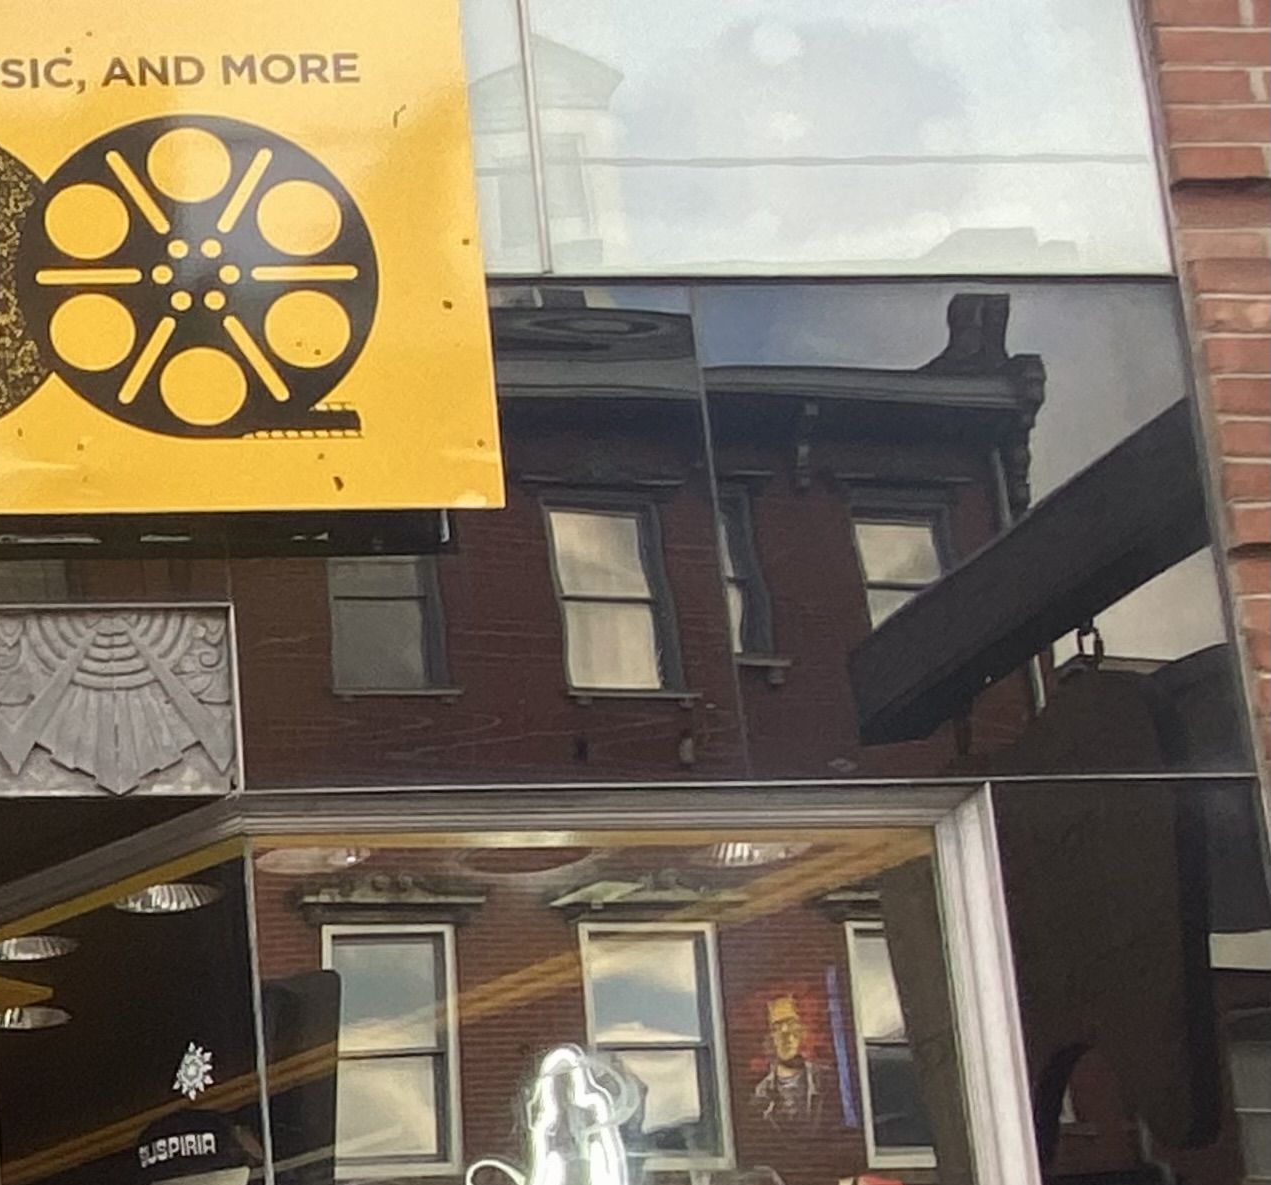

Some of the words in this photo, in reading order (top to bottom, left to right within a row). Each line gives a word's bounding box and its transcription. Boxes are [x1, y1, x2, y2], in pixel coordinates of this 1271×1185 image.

[102, 54, 207, 88] AND
[220, 51, 362, 85] MORE
[138, 1131, 218, 1169] SUSPIRIA
